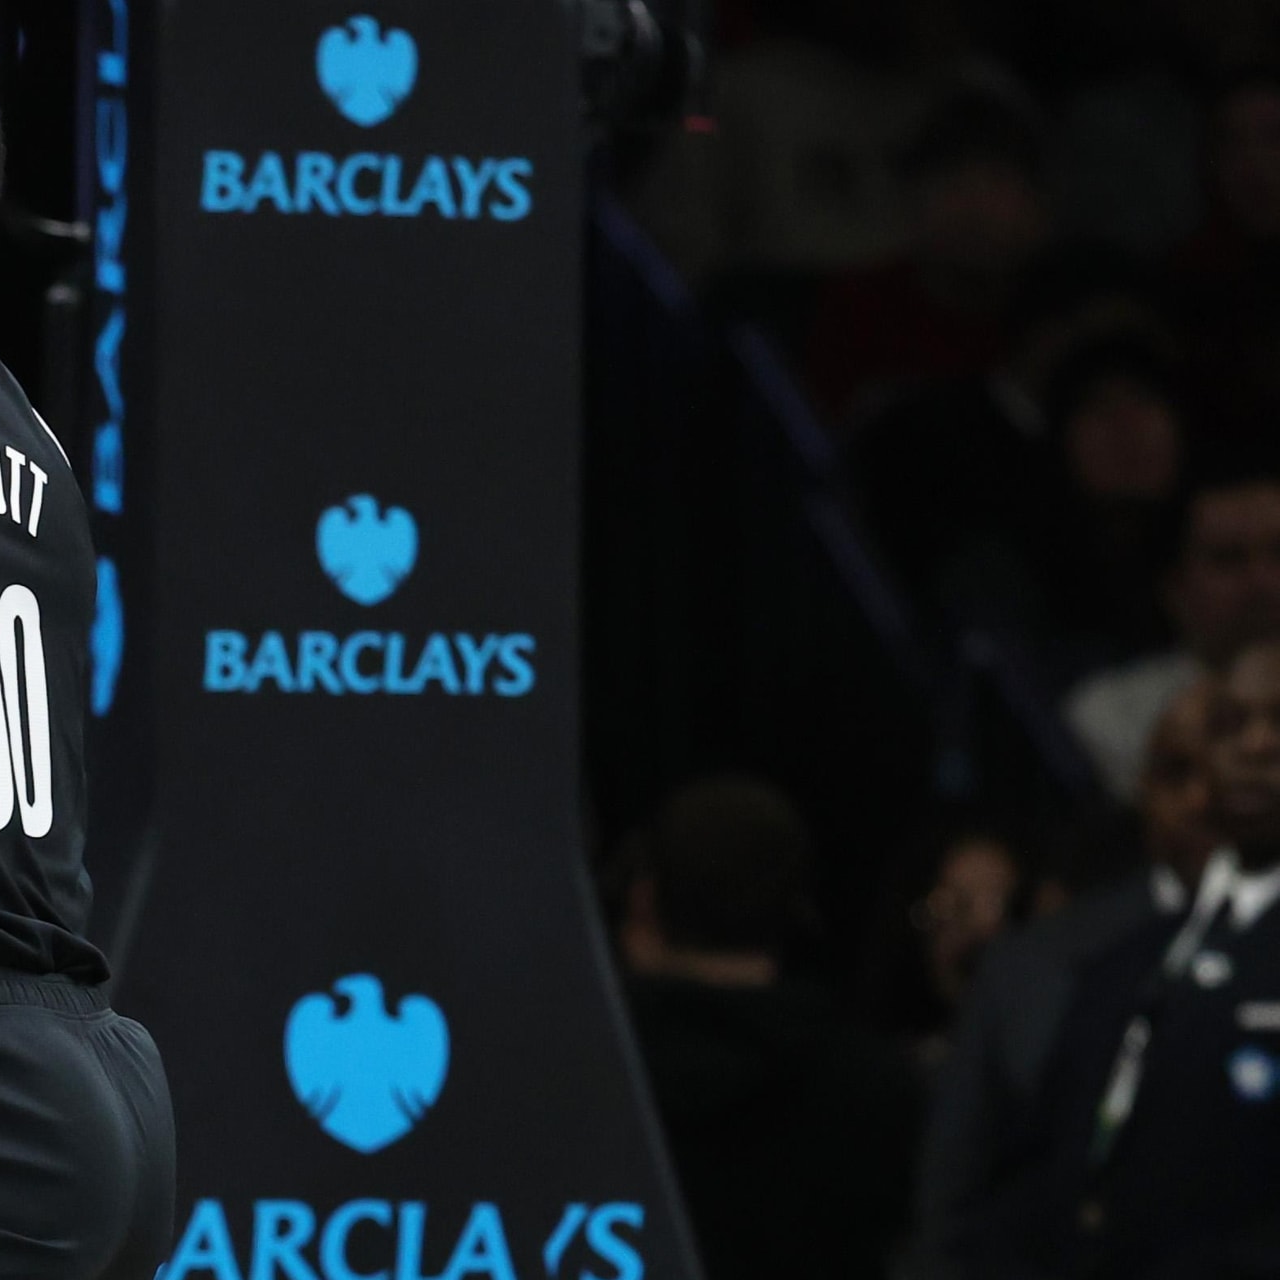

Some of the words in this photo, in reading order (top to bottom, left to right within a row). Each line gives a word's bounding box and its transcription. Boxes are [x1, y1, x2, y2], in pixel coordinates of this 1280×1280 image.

[199, 149, 533, 222] BARCLAYS
[94, 0, 128, 514] BARCL
[202, 629, 536, 697] BARCLAYS
